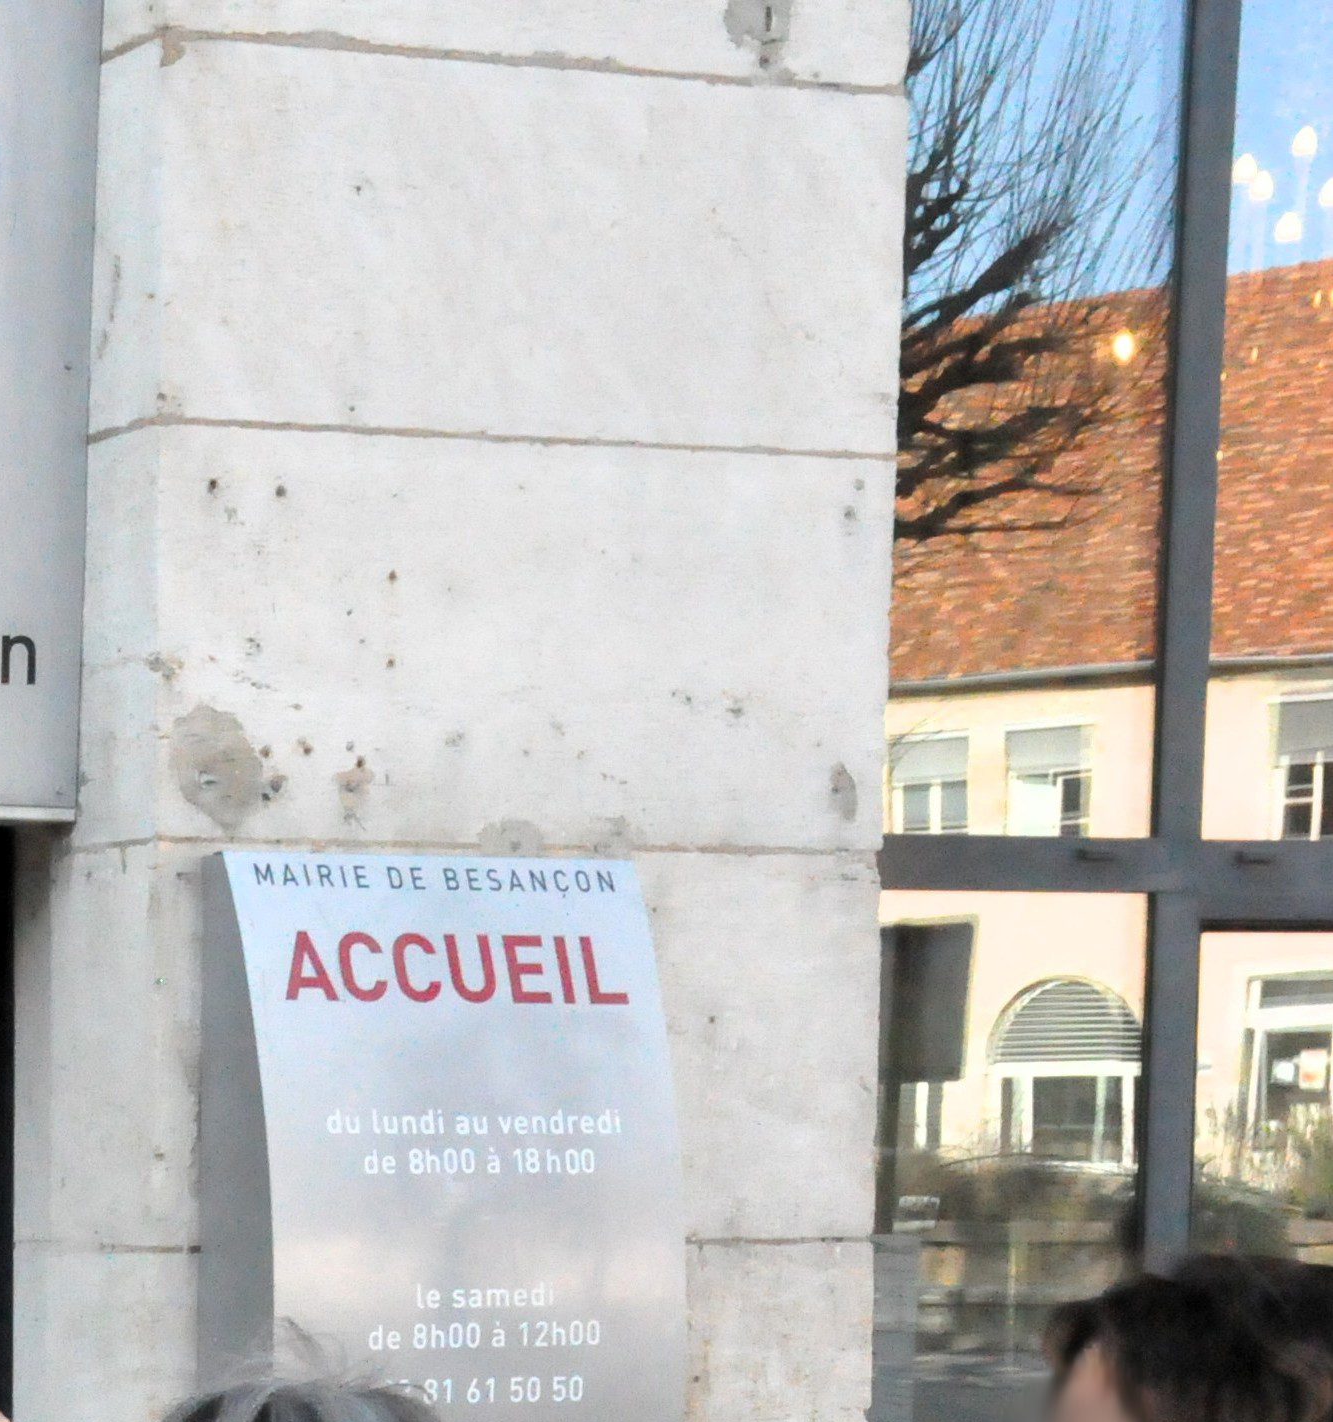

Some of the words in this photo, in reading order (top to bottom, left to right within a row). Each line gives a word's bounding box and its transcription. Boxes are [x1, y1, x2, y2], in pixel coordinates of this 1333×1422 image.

[253, 862, 367, 889] MAIRIE
[387, 866, 426, 891] DE
[444, 867, 617, 898] BESANÇON
[286, 930, 629, 1005] ACCUEIL
[326, 1109, 360, 1134] du
[372, 1109, 445, 1134] lundi
[455, 1115, 488, 1134] au
[499, 1109, 622, 1134] vendredi
[364, 1148, 396, 1174] de
[409, 1148, 475, 1174] 8h00
[486, 1146, 501, 1173] à
[513, 1147, 595, 1174] 18h00
[416, 1284, 440, 1309] le
[452, 1281, 554, 1308] samedi
[369, 1323, 401, 1350] de
[413, 1321, 481, 1349] 8h00
[492, 1320, 505, 1348] à
[519, 1320, 601, 1347] 12h00
[423, 1378, 453, 1404] 81
[467, 1377, 495, 1403] 61
[510, 1376, 541, 1402] 50
[553, 1375, 584, 1401] 50
